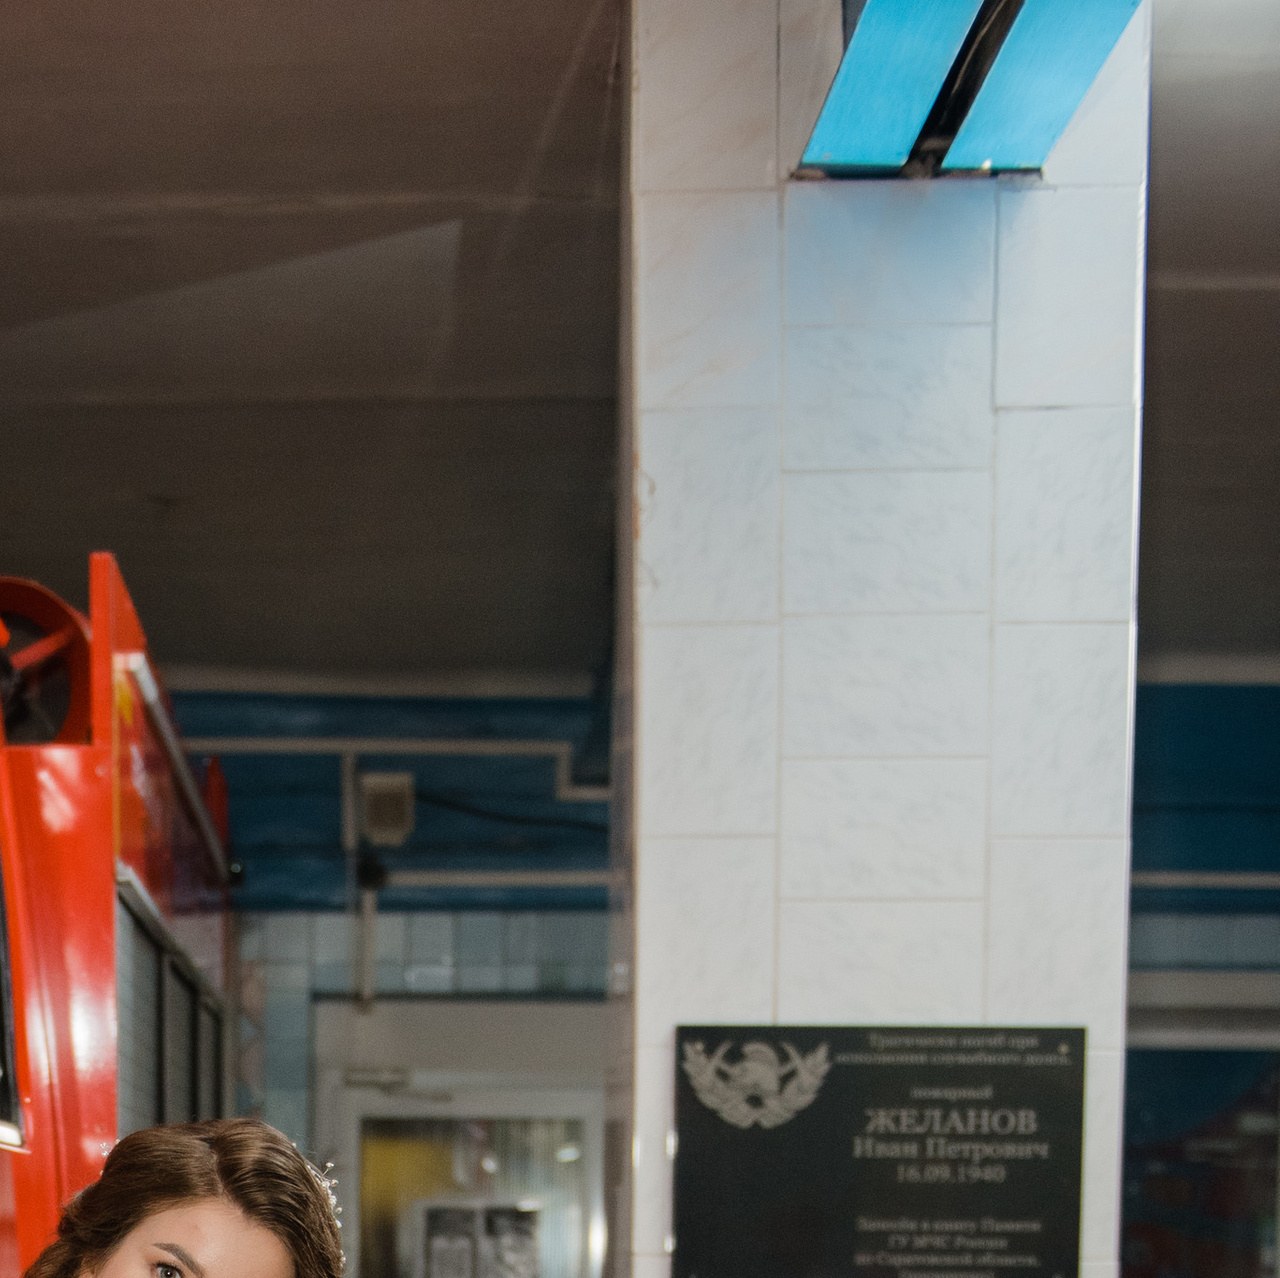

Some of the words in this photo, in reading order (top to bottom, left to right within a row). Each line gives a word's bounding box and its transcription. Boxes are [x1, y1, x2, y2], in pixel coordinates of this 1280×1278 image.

[864, 1108, 1038, 1135] ЖЕЛАНОВ
[853, 1136, 918, 1159] Иван
[926, 1137, 1049, 1164] Петрович
